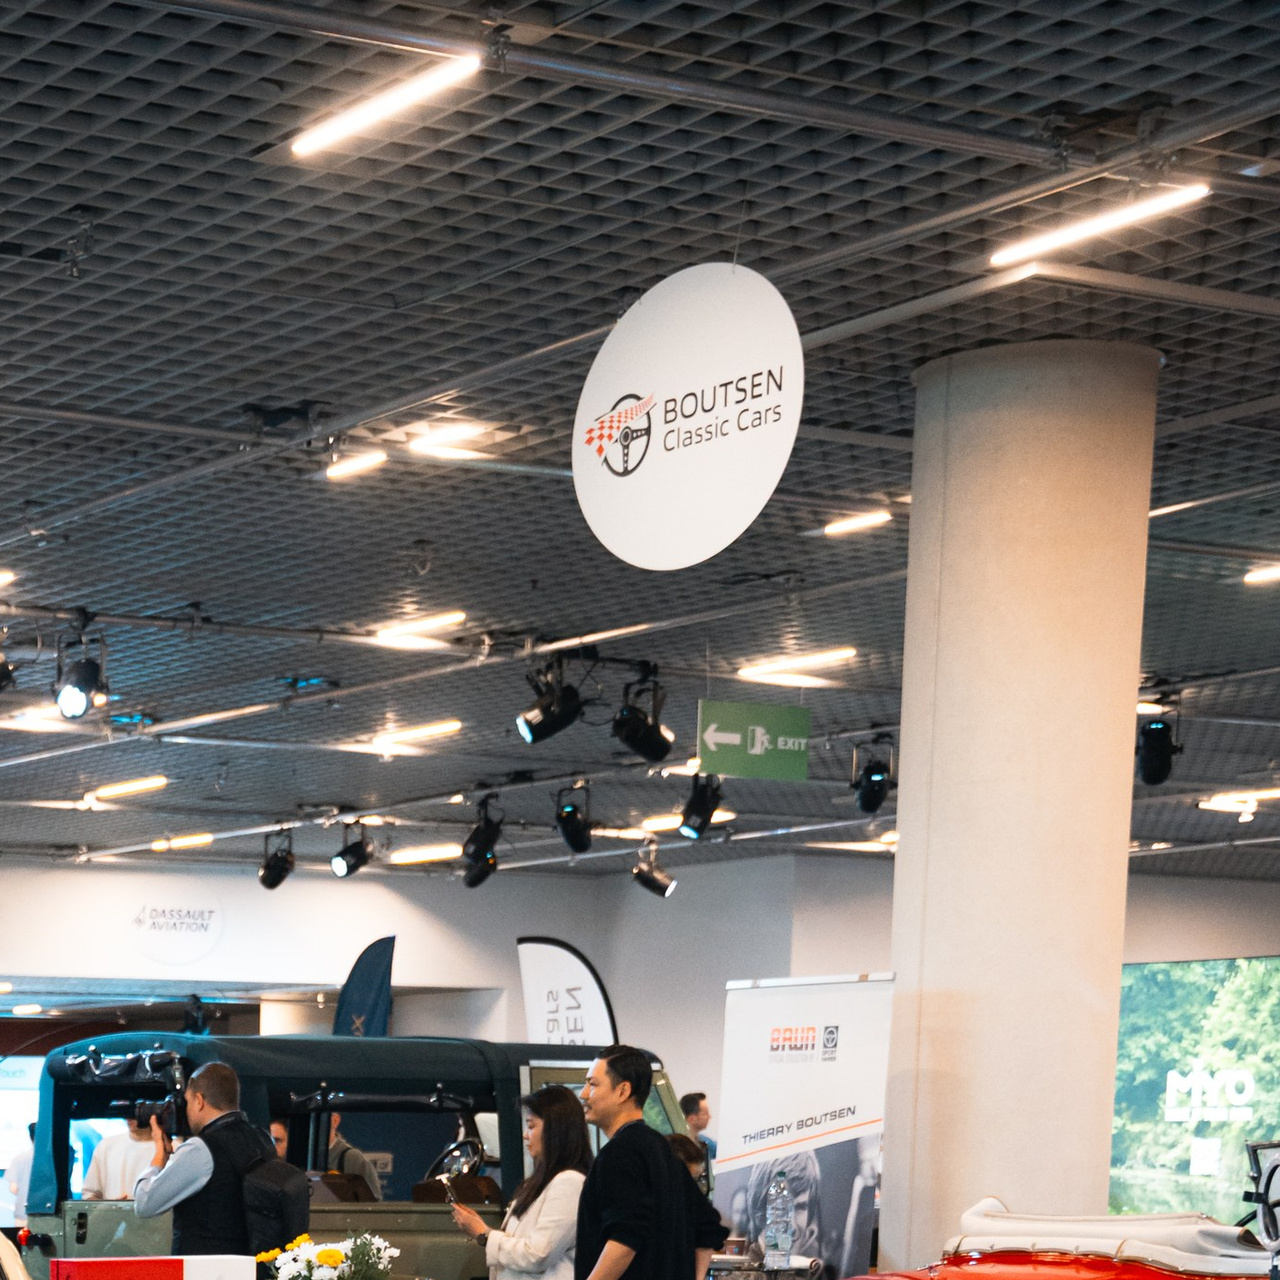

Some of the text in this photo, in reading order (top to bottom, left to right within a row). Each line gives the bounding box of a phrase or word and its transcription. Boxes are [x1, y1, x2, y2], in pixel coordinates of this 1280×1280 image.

[663, 366, 784, 425] BOUTSEN
[663, 403, 782, 452] Classic Cars
[777, 736, 807, 751] EXIT
[149, 908, 215, 921] DASSAULT
[150, 921, 209, 932] AVIATION
[742, 1105, 856, 1144] THIERRY BOUTSEN
